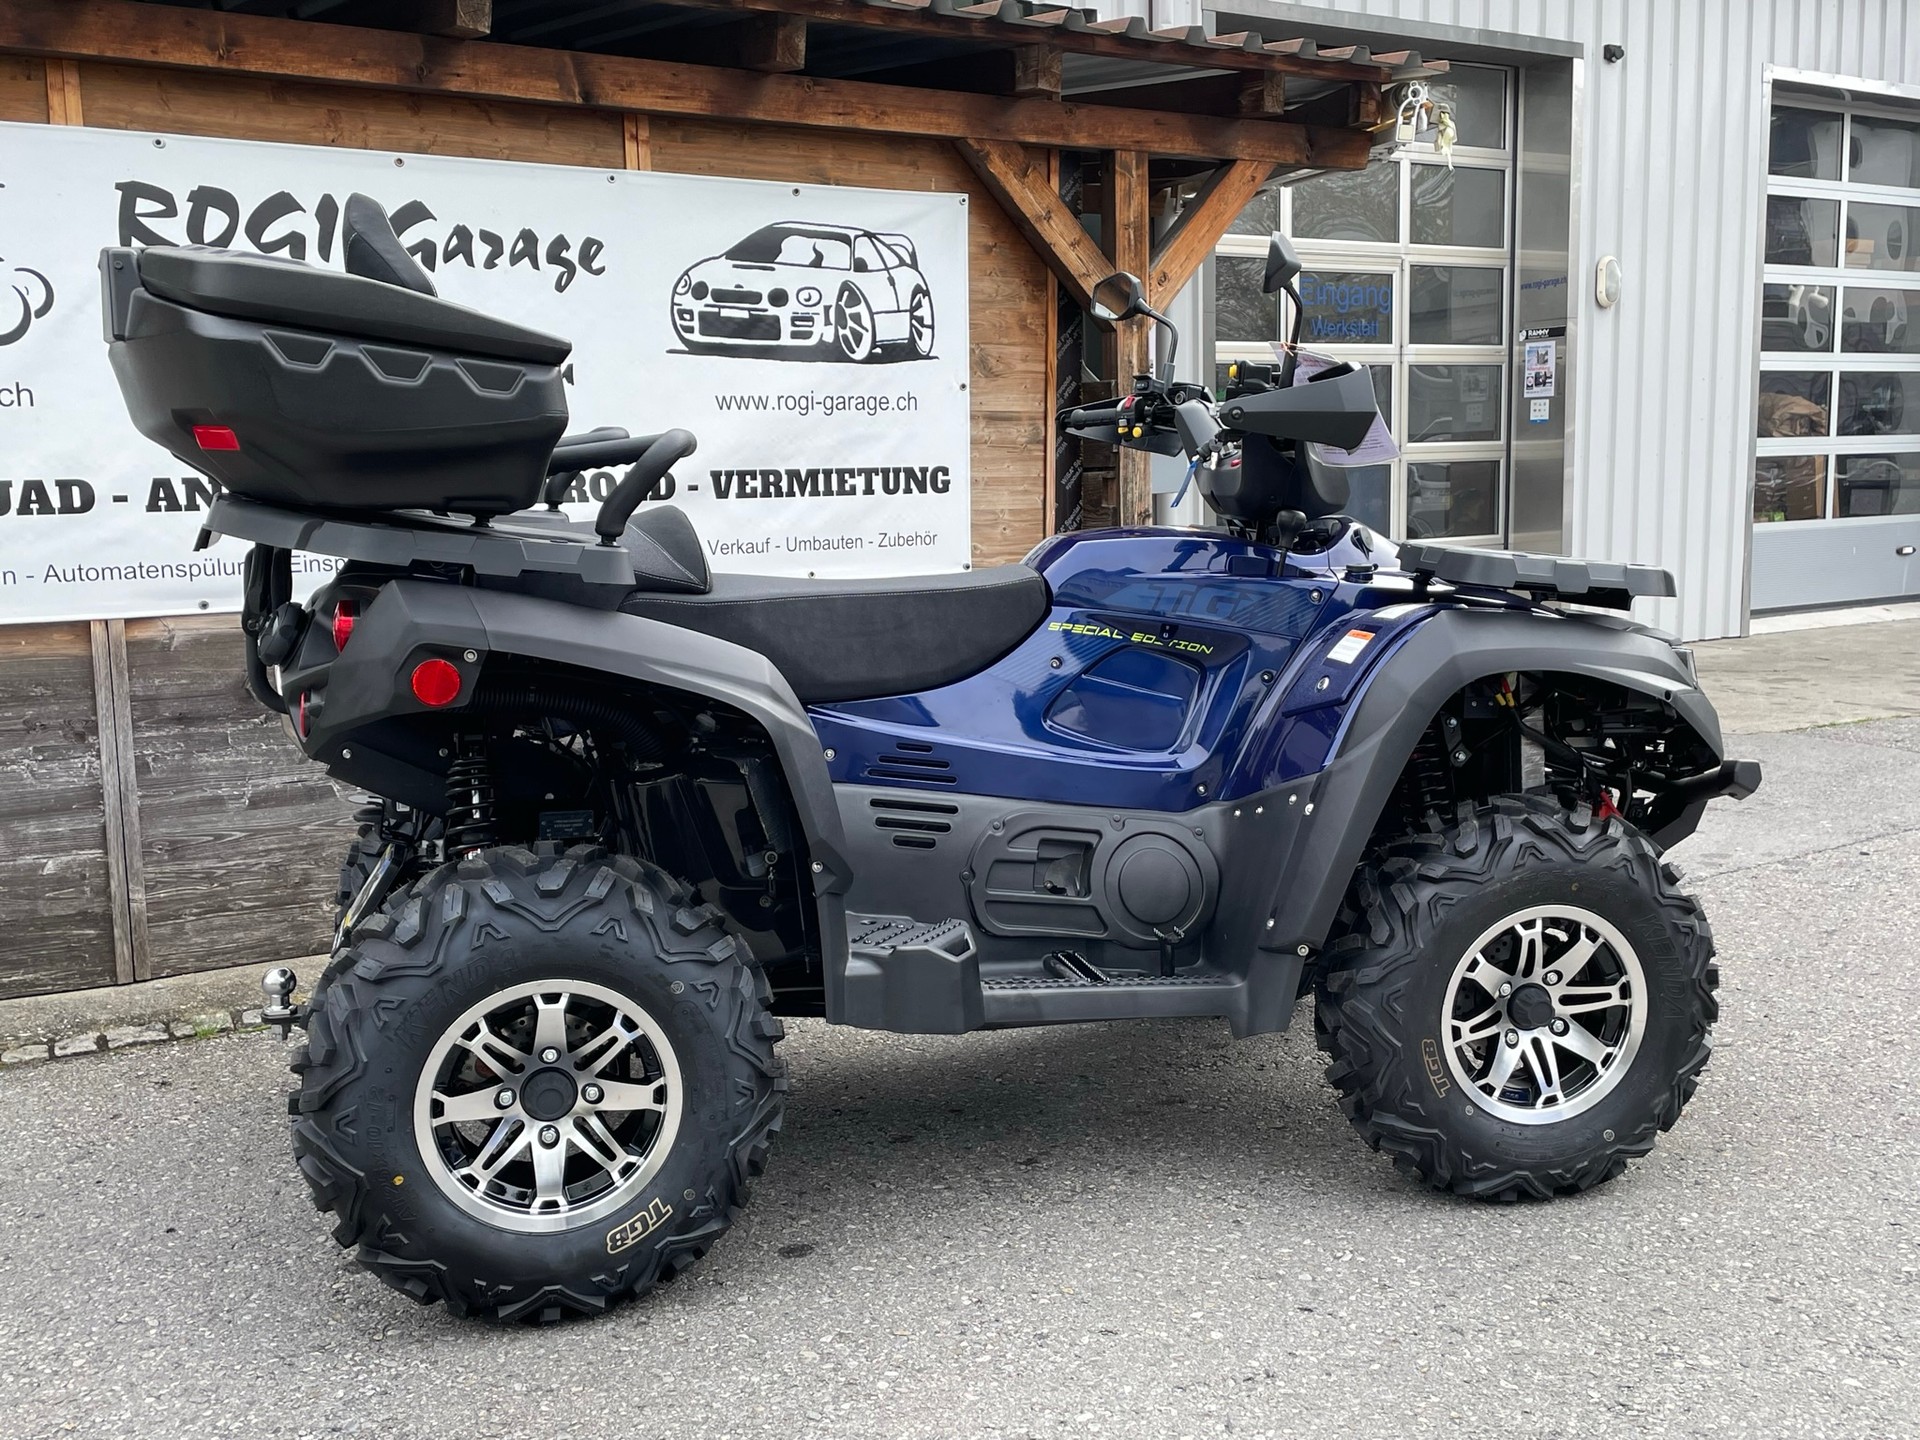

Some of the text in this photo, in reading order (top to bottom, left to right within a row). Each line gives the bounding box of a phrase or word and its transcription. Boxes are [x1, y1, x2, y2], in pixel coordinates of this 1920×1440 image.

[114, 180, 606, 293] ROGI Garage
[1299, 277, 1391, 314] Eingang
[1311, 318, 1380, 337] Werkstatt
[714, 391, 919, 417] www.rogi-garage.ch
[709, 466, 951, 499] VERMIETUNG
[707, 537, 771, 555] Verkauf
[785, 534, 864, 553] Umbauten
[877, 531, 938, 549] Zubehör
[1048, 621, 1123, 641] SPECIAL
[1421, 1038, 1452, 1099] TGB
[606, 1196, 674, 1255] TGB
